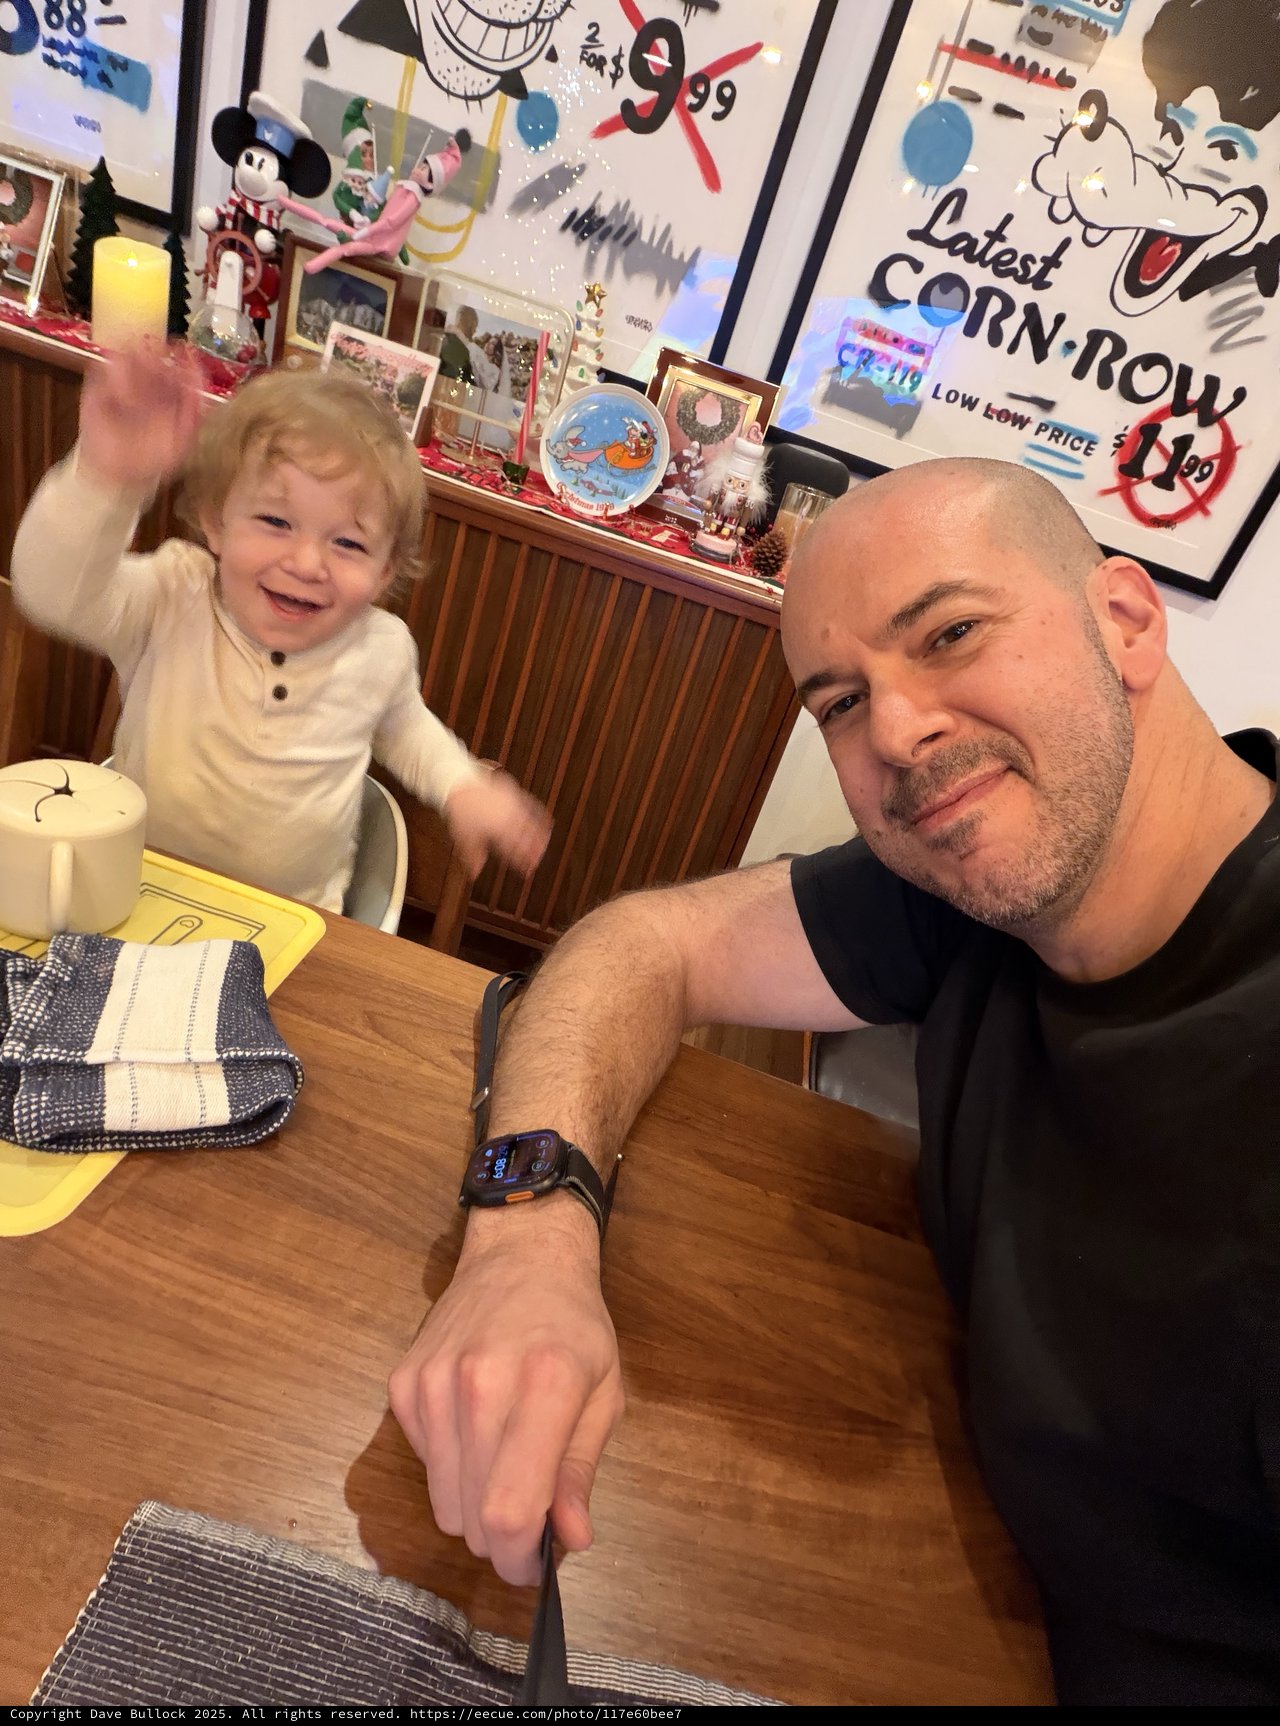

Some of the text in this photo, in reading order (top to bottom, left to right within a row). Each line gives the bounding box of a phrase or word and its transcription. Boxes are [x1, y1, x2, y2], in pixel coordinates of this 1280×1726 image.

[585, 21, 600, 43] 2
[579, 49, 607, 78] FOR
[907, 188, 1072, 290] Latest
[931, 383, 980, 412] LOW
[983, 403, 1031, 430] LOW
[1034, 422, 1098, 457] PRICE
